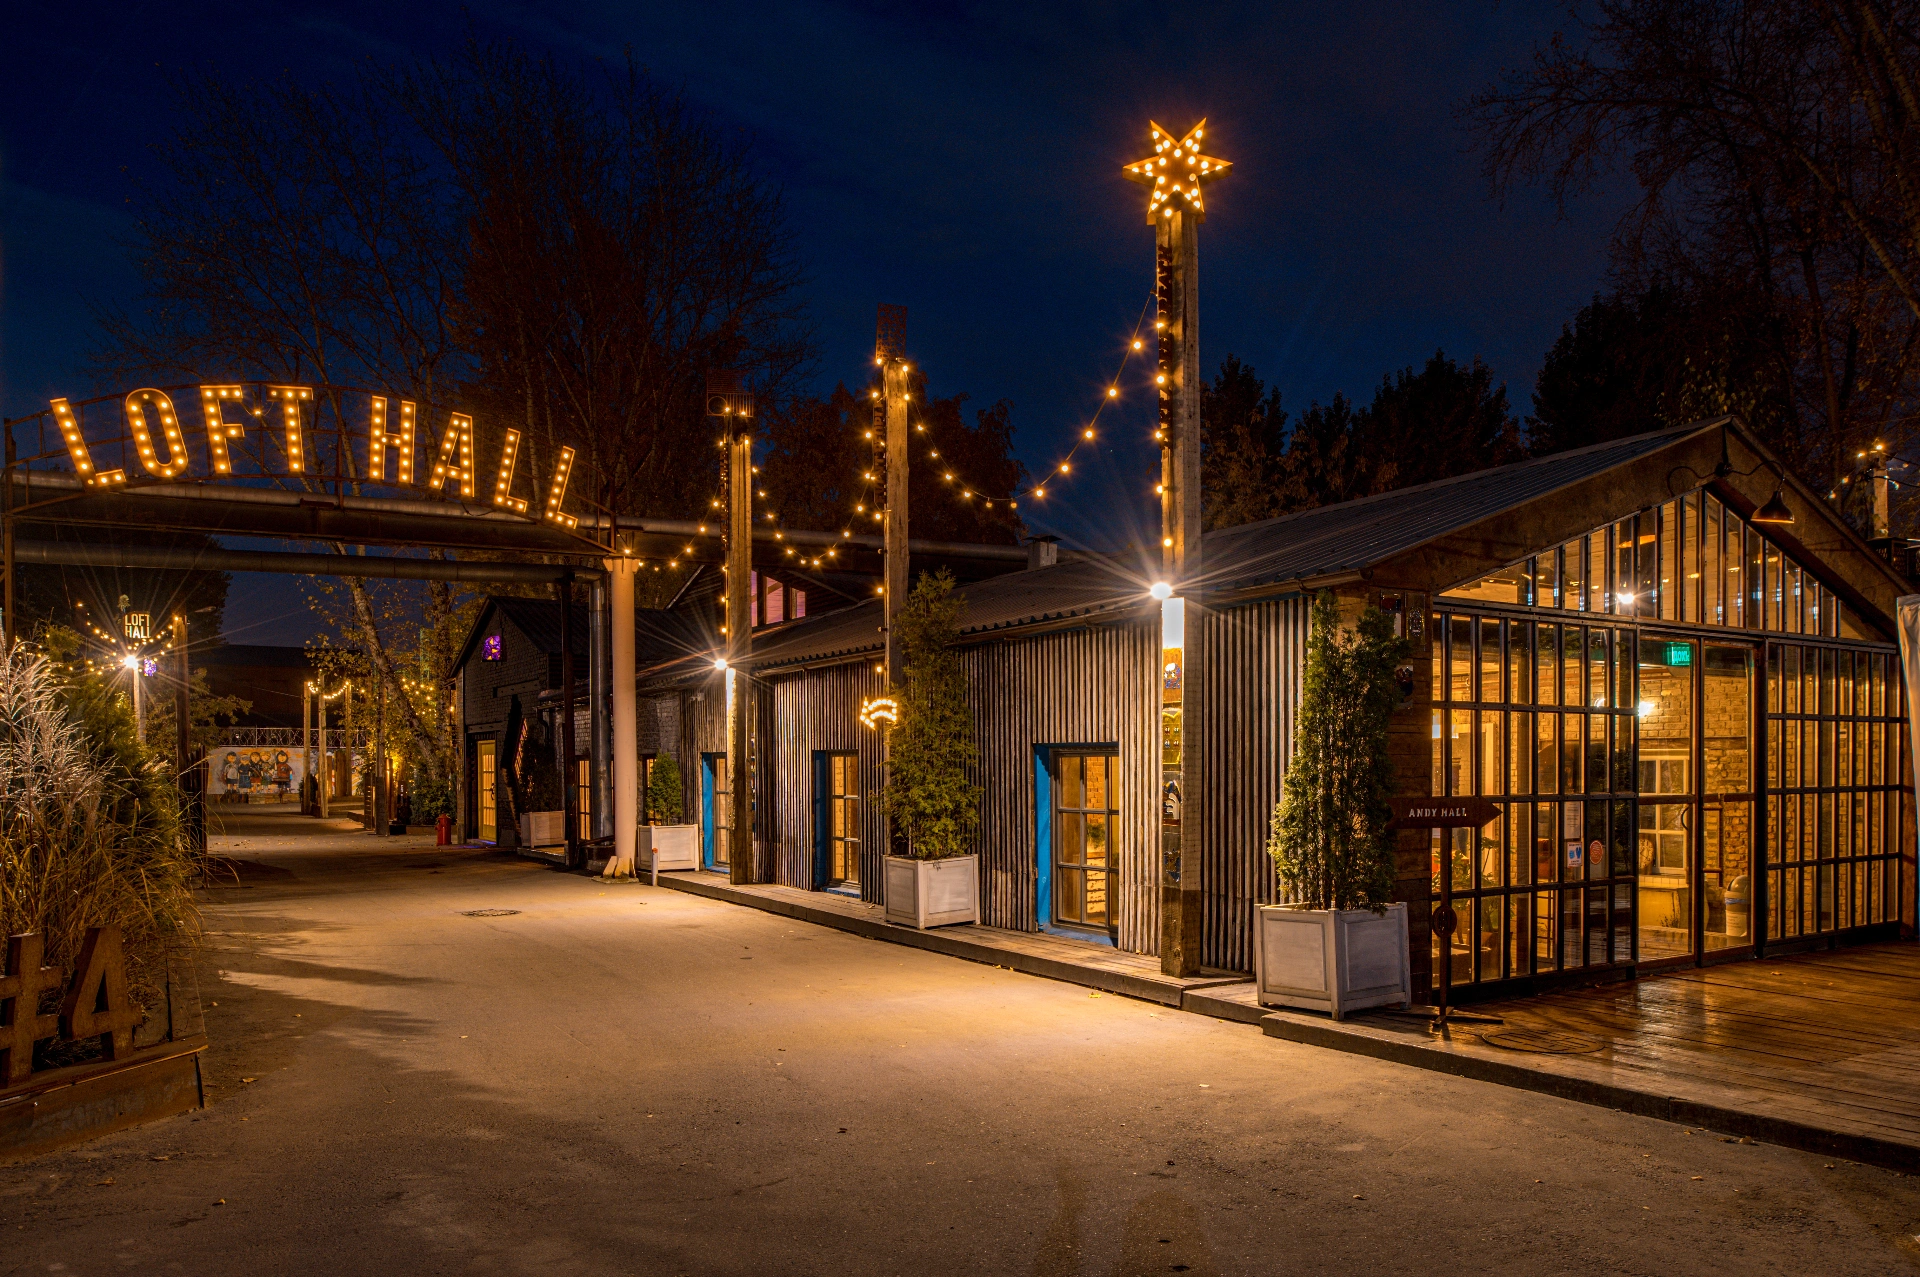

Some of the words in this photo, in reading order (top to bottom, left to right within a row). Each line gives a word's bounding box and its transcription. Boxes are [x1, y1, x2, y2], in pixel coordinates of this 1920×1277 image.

[50, 384, 314, 491] LOFT
[370, 395, 578, 529] HALL
[125, 613, 150, 626] LOFT
[125, 625, 151, 639] HALL
[1408, 808, 1438, 818] ANDY
[1440, 807, 1467, 817] HALL
